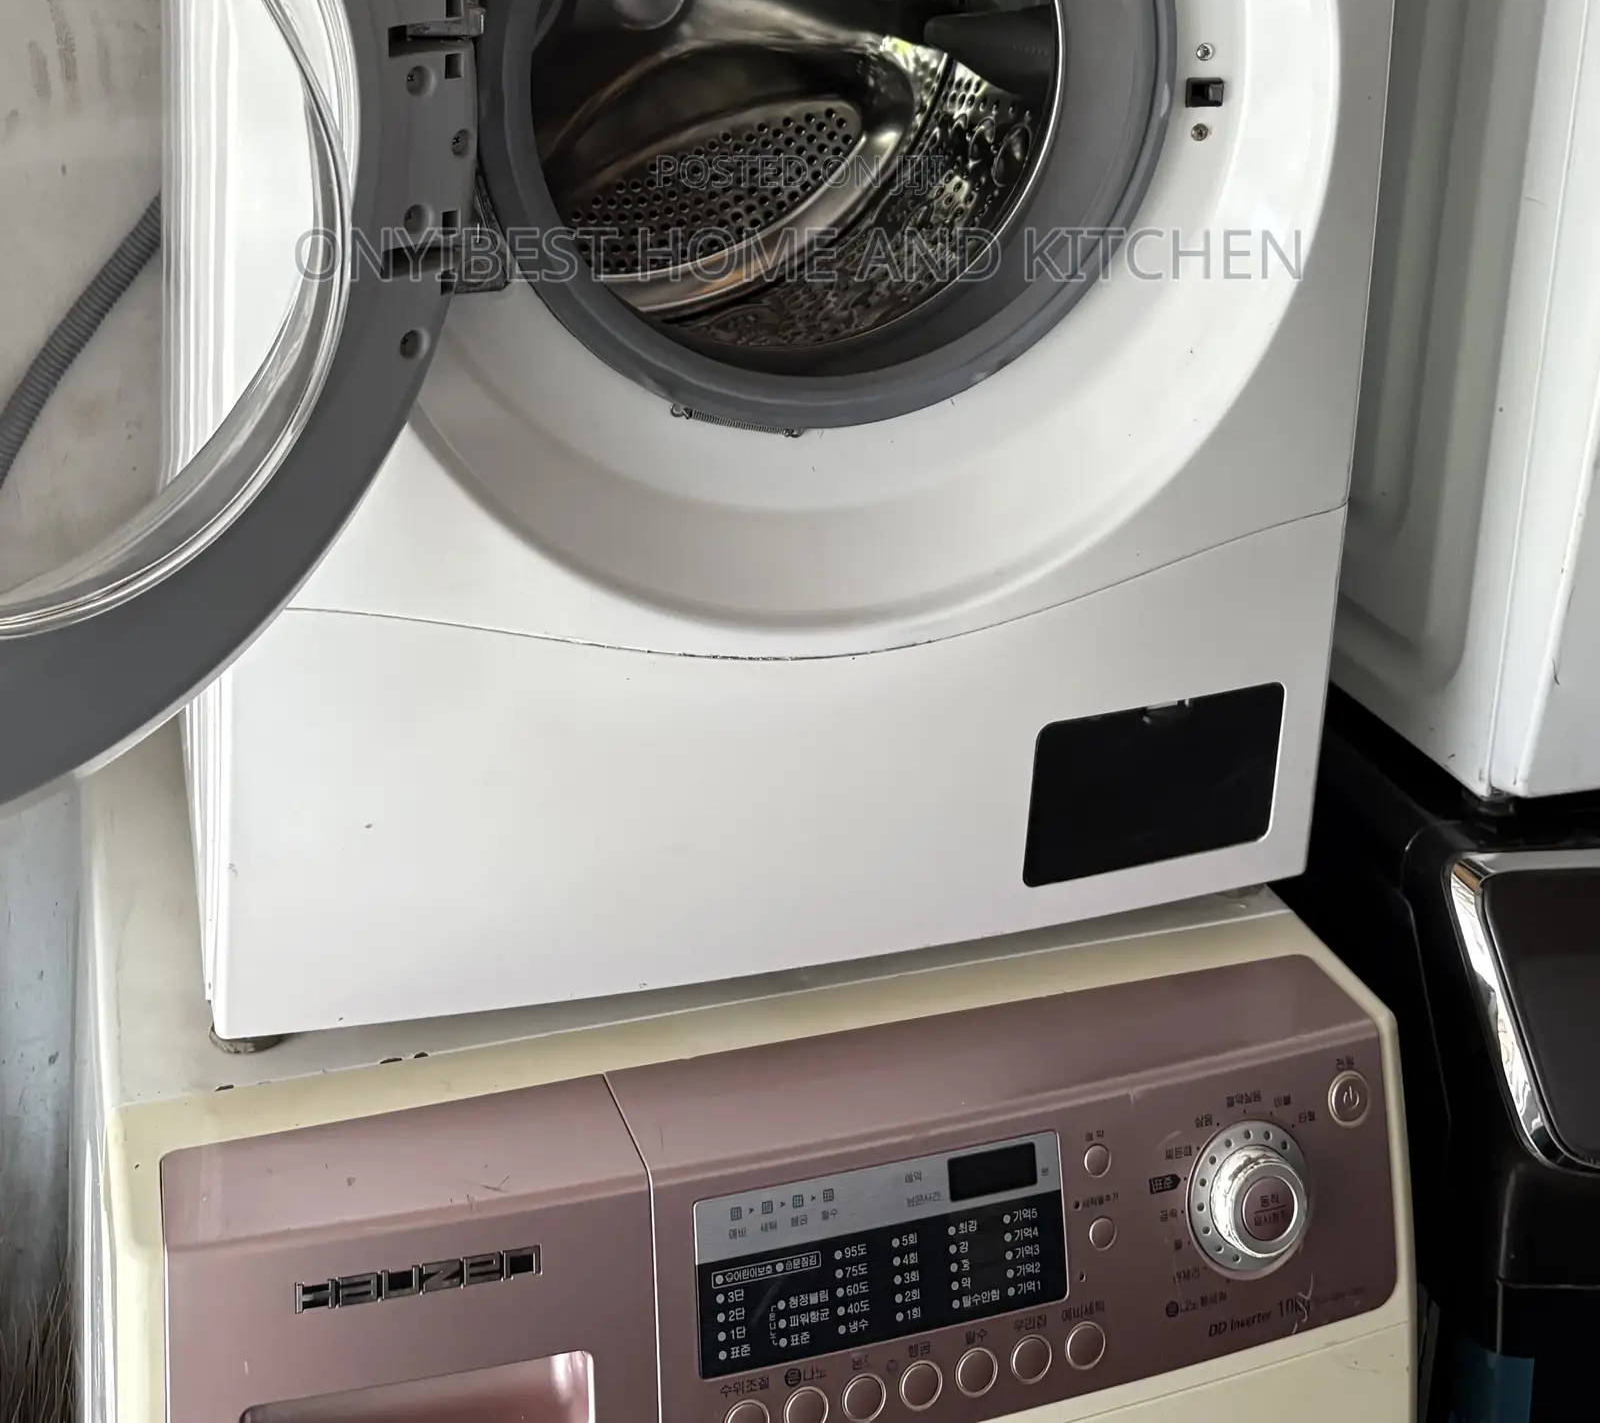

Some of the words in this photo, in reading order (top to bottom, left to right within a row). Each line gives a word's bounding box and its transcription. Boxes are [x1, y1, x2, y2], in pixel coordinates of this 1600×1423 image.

[1013, 1208, 1038, 1222] 기억5
[958, 1219, 978, 1234] 최강
[1014, 1226, 1039, 1241] 기억4
[902, 1232, 918, 1246] 5회
[844, 1243, 868, 1259] 95도
[902, 1251, 918, 1265] 4회
[1015, 1244, 1040, 1259] 기억3
[733, 1264, 773, 1282] 어린이보호
[845, 1262, 868, 1278] 75도
[904, 1269, 920, 1284] 3회
[1016, 1262, 1041, 1277] 기억2
[846, 1281, 869, 1297] 60도
[961, 1277, 972, 1289] 약
[1017, 1280, 1042, 1295] 기억1
[727, 1288, 745, 1303] 3단
[904, 1288, 920, 1303] 2회
[962, 1288, 1000, 1308] 탈수안함
[728, 1307, 746, 1322] 2단
[847, 1299, 870, 1315] 40도
[906, 1306, 921, 1320] 1회
[789, 1308, 830, 1327] 파워항균
[1208, 1321, 1228, 1338] DD
[1230, 1309, 1272, 1332] Inverter
[730, 1326, 746, 1340] 1단
[848, 1318, 869, 1334] 냉수
[790, 1331, 811, 1347] 표준
[730, 1344, 751, 1359] 표준
